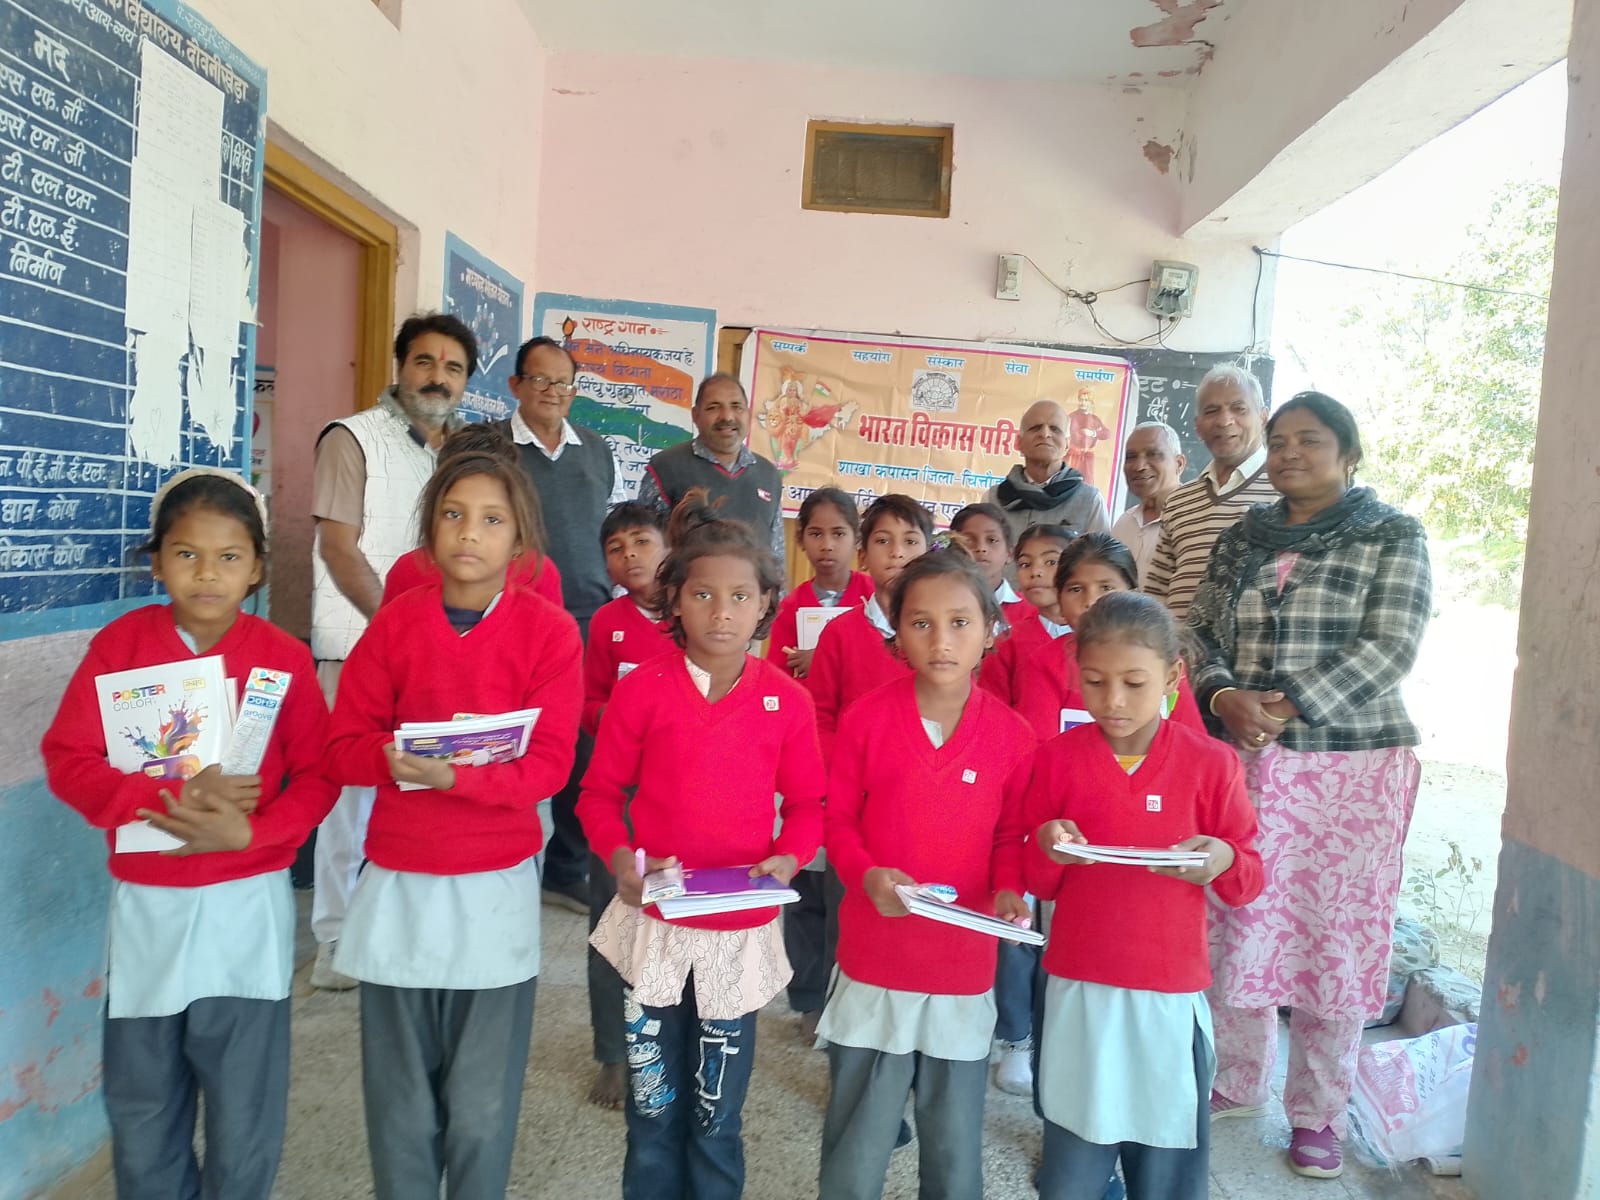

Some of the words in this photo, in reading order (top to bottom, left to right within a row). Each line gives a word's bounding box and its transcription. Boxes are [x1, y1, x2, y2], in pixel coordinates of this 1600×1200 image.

[9, 240, 67, 286] निर्माण
[582, 317, 616, 335] राष्ट्र
[618, 320, 652, 335] गान
[853, 350, 891, 363] सहयोग
[927, 354, 965, 368] संस्कार
[1005, 360, 1029, 375] सेवा
[1075, 368, 1115, 383] समर्पण
[859, 414, 908, 446] भारत
[910, 412, 977, 453] विकास
[838, 461, 870, 477] शाखा
[875, 465, 918, 481] कपासन
[112, 683, 166, 703] POSTER
[113, 697, 153, 712] COLOR
